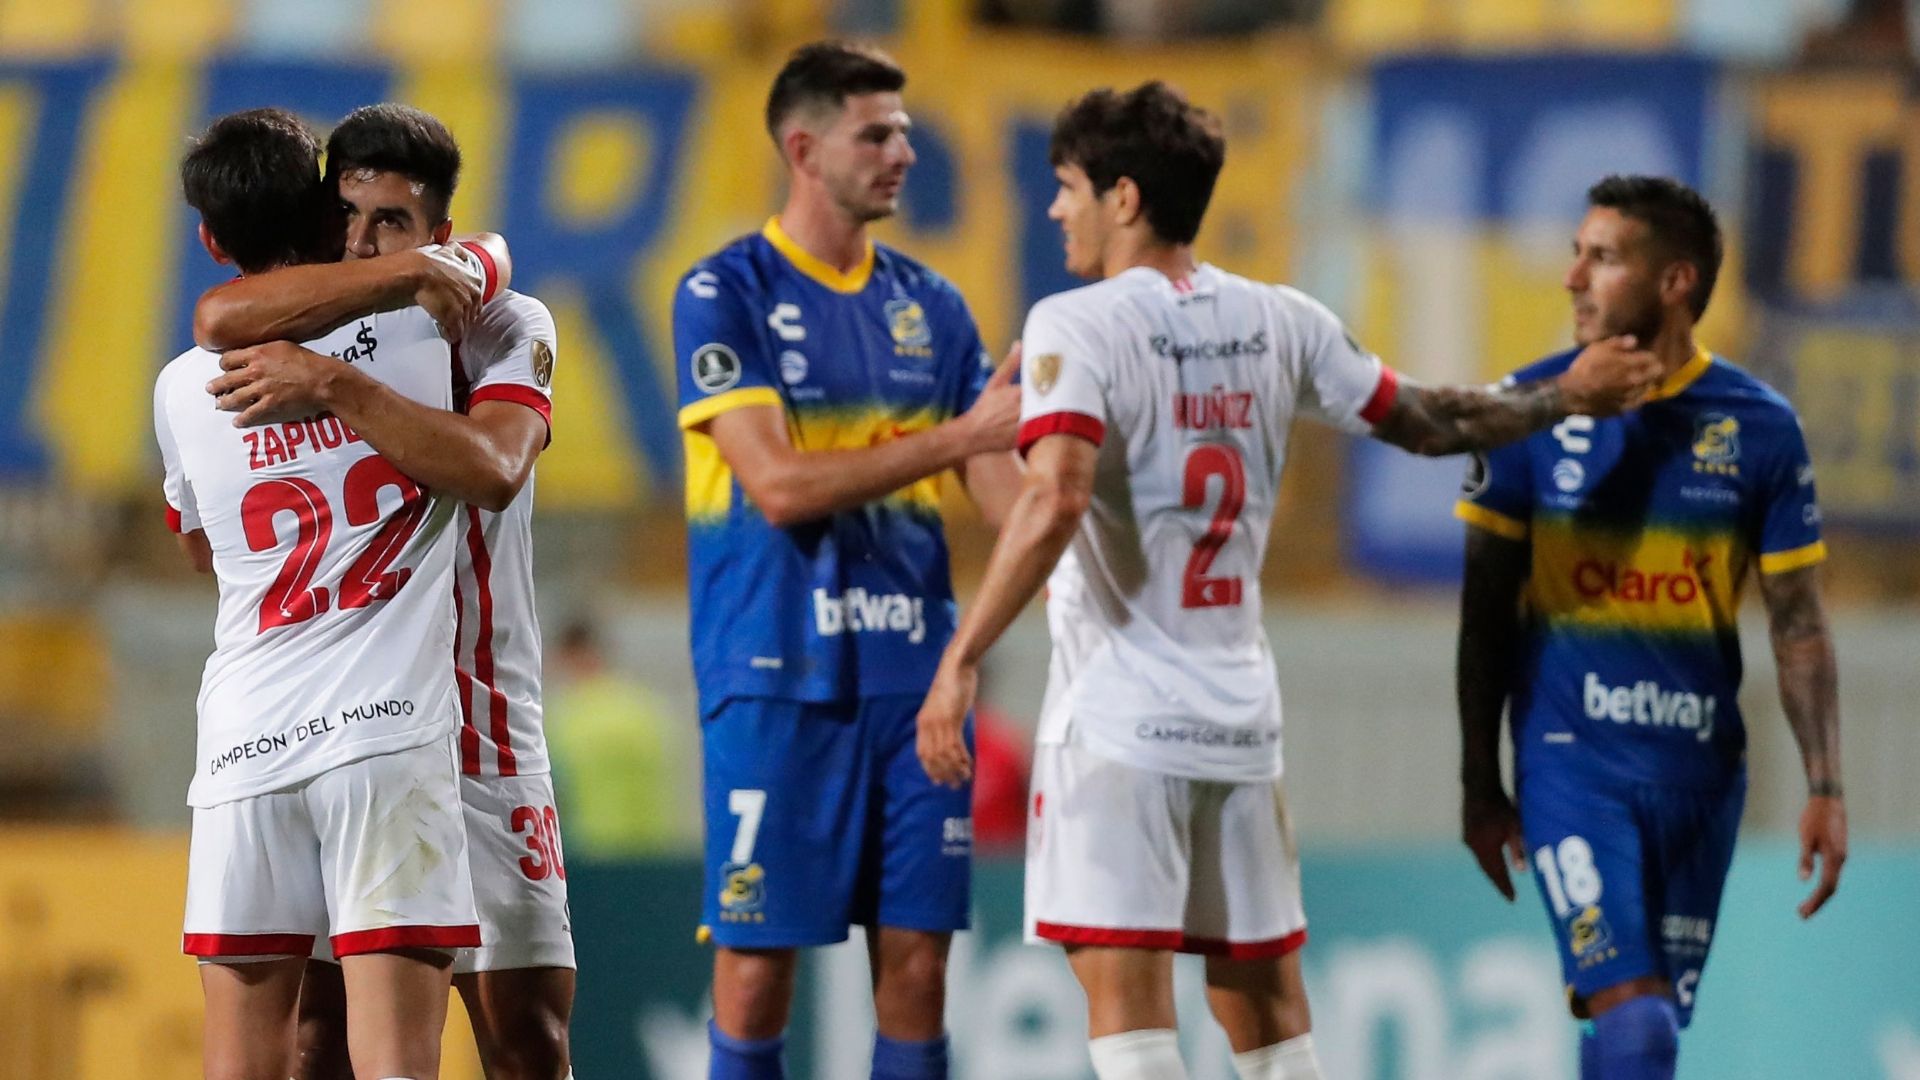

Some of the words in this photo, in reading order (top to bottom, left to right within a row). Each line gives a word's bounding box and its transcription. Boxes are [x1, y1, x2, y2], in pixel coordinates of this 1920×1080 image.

[243, 411, 362, 470] ZAPIOL
[241, 454, 428, 636] 22
[1181, 444, 1246, 608] 2
[813, 587, 926, 644] btway
[1572, 556, 1700, 606] Claro
[210, 733, 288, 776] CAMPEÓN
[296, 716, 335, 742] DEL
[341, 700, 414, 725] MUNDO
[1584, 671, 1716, 743] betway
[510, 805, 566, 881] 30
[729, 789, 767, 863] 7
[1535, 835, 1603, 919] 18
